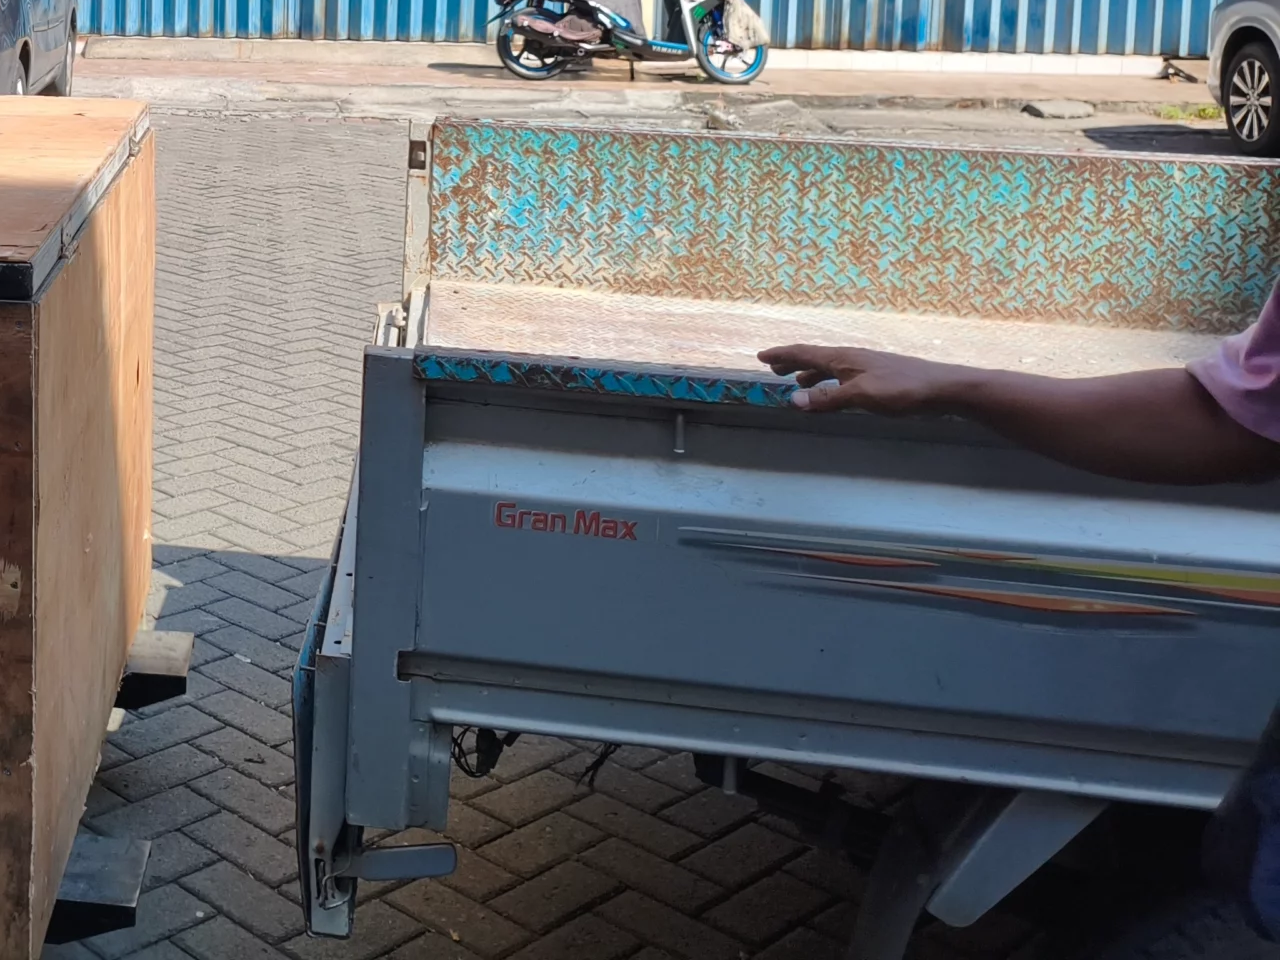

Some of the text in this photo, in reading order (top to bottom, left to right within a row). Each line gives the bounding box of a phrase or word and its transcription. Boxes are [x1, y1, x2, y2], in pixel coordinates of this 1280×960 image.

[651, 45, 683, 55] YAMAHA
[495, 501, 638, 541] Gran Max
